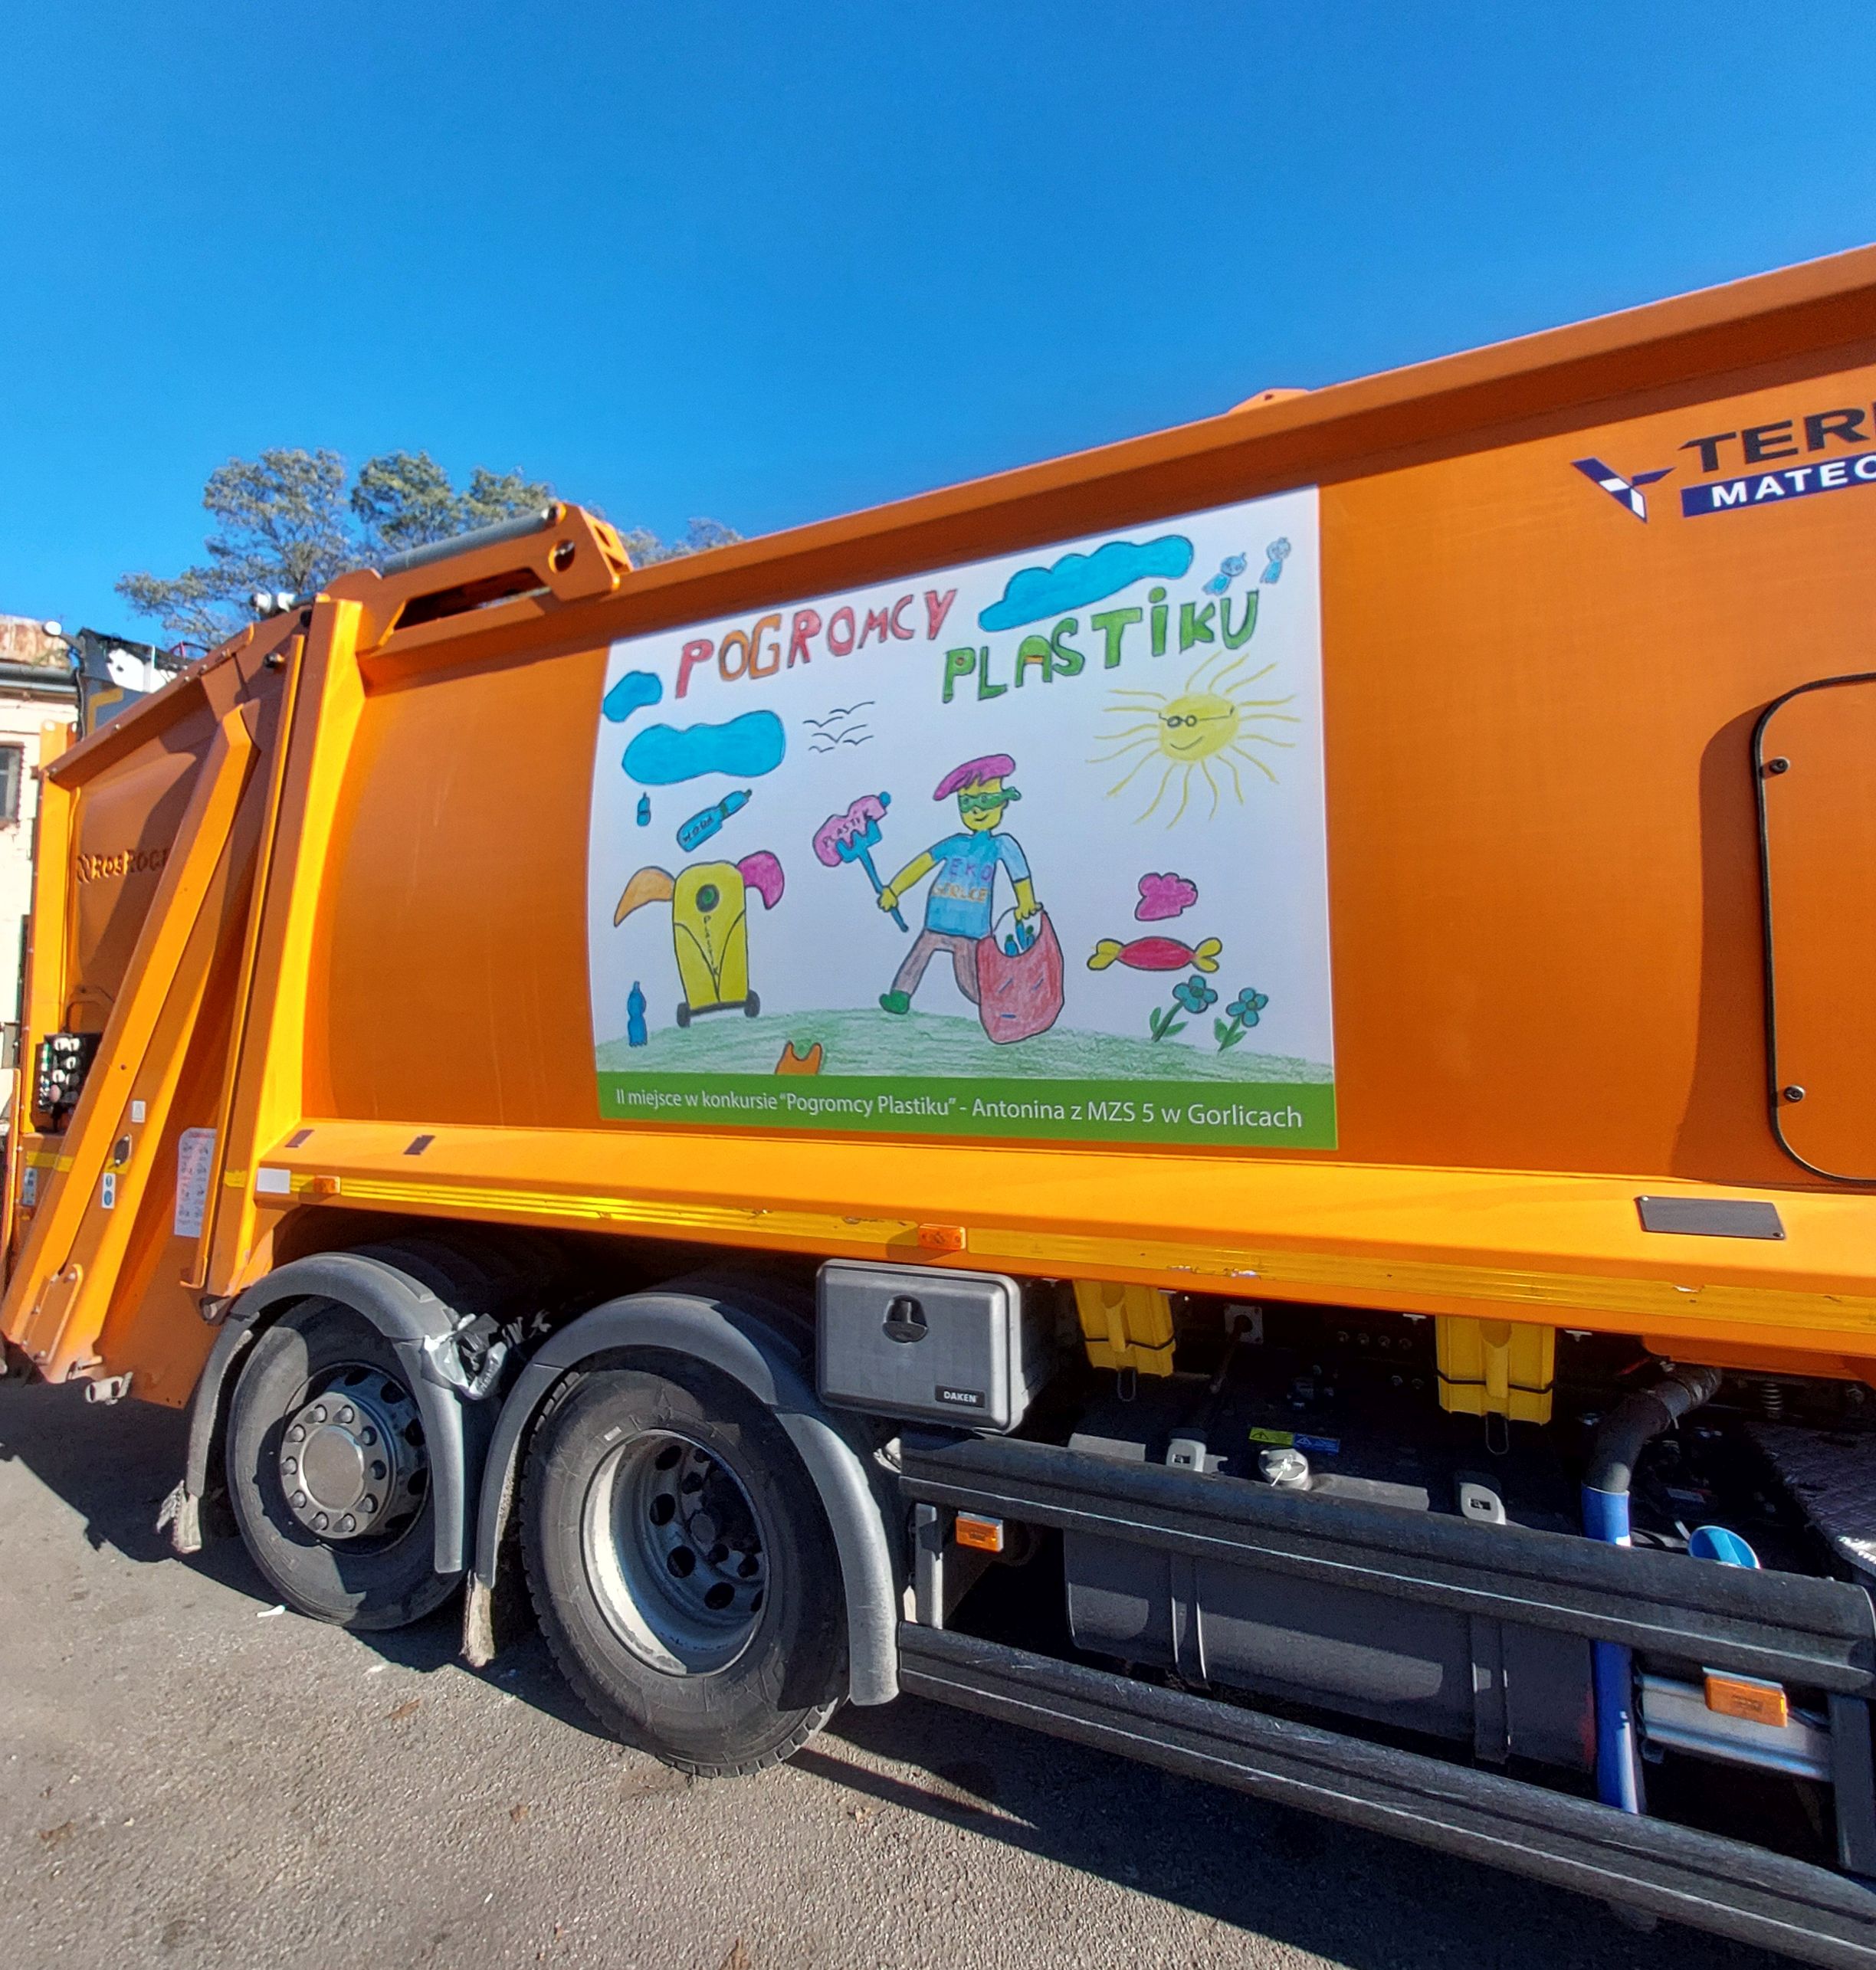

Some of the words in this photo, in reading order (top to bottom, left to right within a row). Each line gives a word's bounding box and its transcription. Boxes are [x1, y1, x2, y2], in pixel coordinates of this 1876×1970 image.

[1678, 402, 1876, 473] TER
[674, 588, 958, 699] POGROMCY
[949, 857, 995, 882] EKO
[628, 1090, 681, 1111] miejsce
[686, 1096, 698, 1106] w
[702, 1091, 777, 1110] konkursie
[779, 1092, 873, 1117] “Pogromcy
[878, 1096, 956, 1116] Plastiku”
[972, 1098, 1065, 1119] Antonina
[1071, 1106, 1081, 1119] z
[1087, 1101, 1134, 1122] MZS
[1142, 1103, 1154, 1123] 5
[1161, 1108, 1181, 1123] w
[1188, 1104, 1303, 1128] Gorlicach
[943, 1391, 977, 1404] DAKEN
